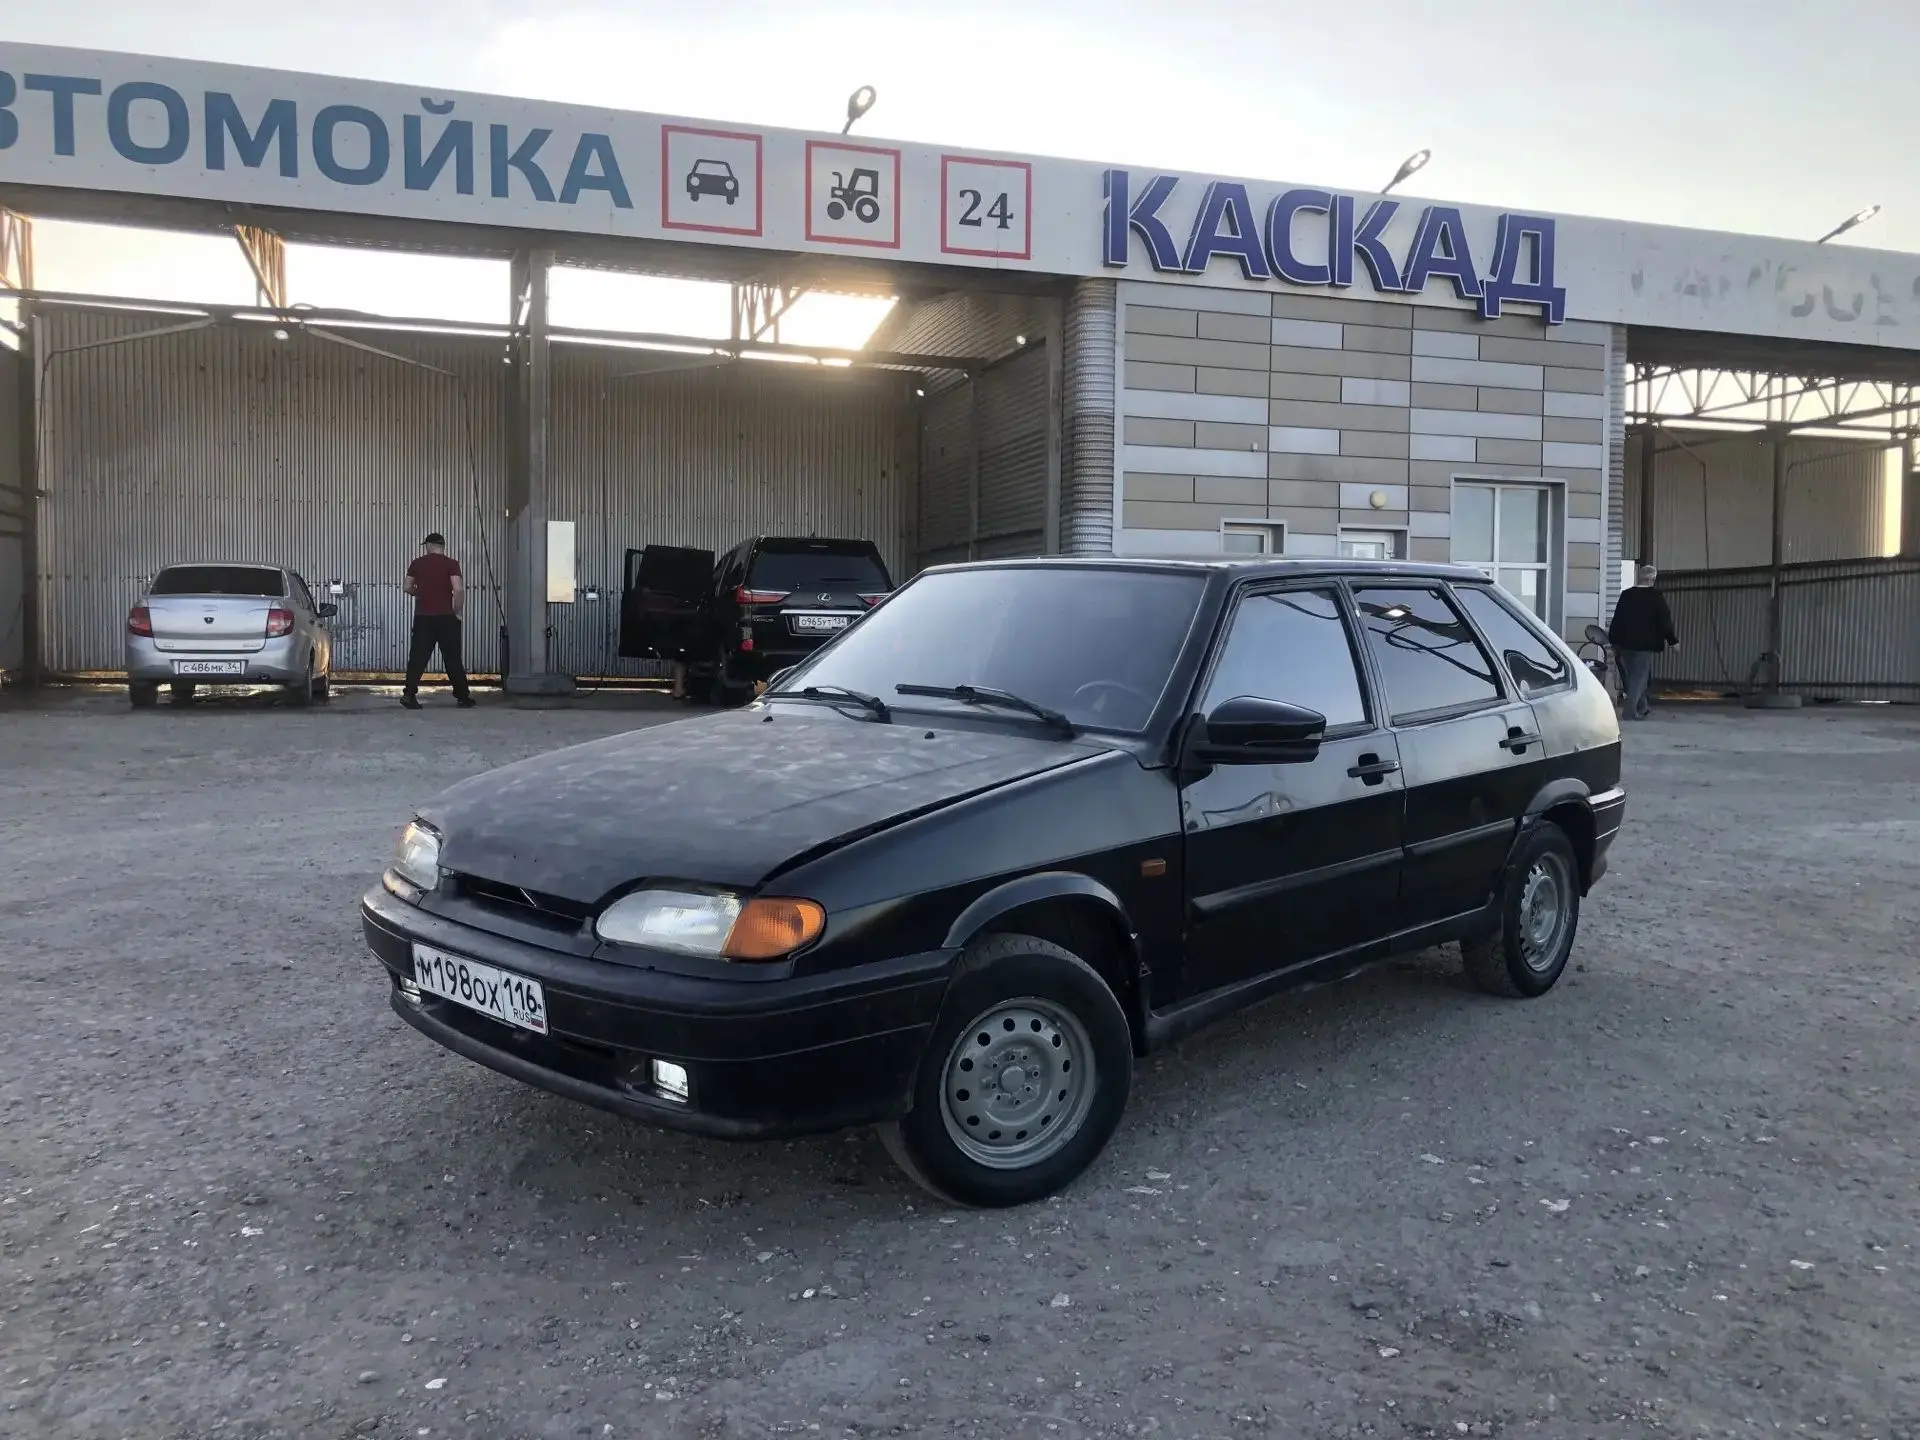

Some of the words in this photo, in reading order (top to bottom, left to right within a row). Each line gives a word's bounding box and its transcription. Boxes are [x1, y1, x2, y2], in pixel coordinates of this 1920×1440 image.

[0, 70, 634, 209] ТОМОЙКА
[958, 189, 1014, 229] 24
[1103, 169, 1567, 326] КАСКАД
[503, 977, 537, 1014] 116
[513, 1008, 531, 1023] RUS
